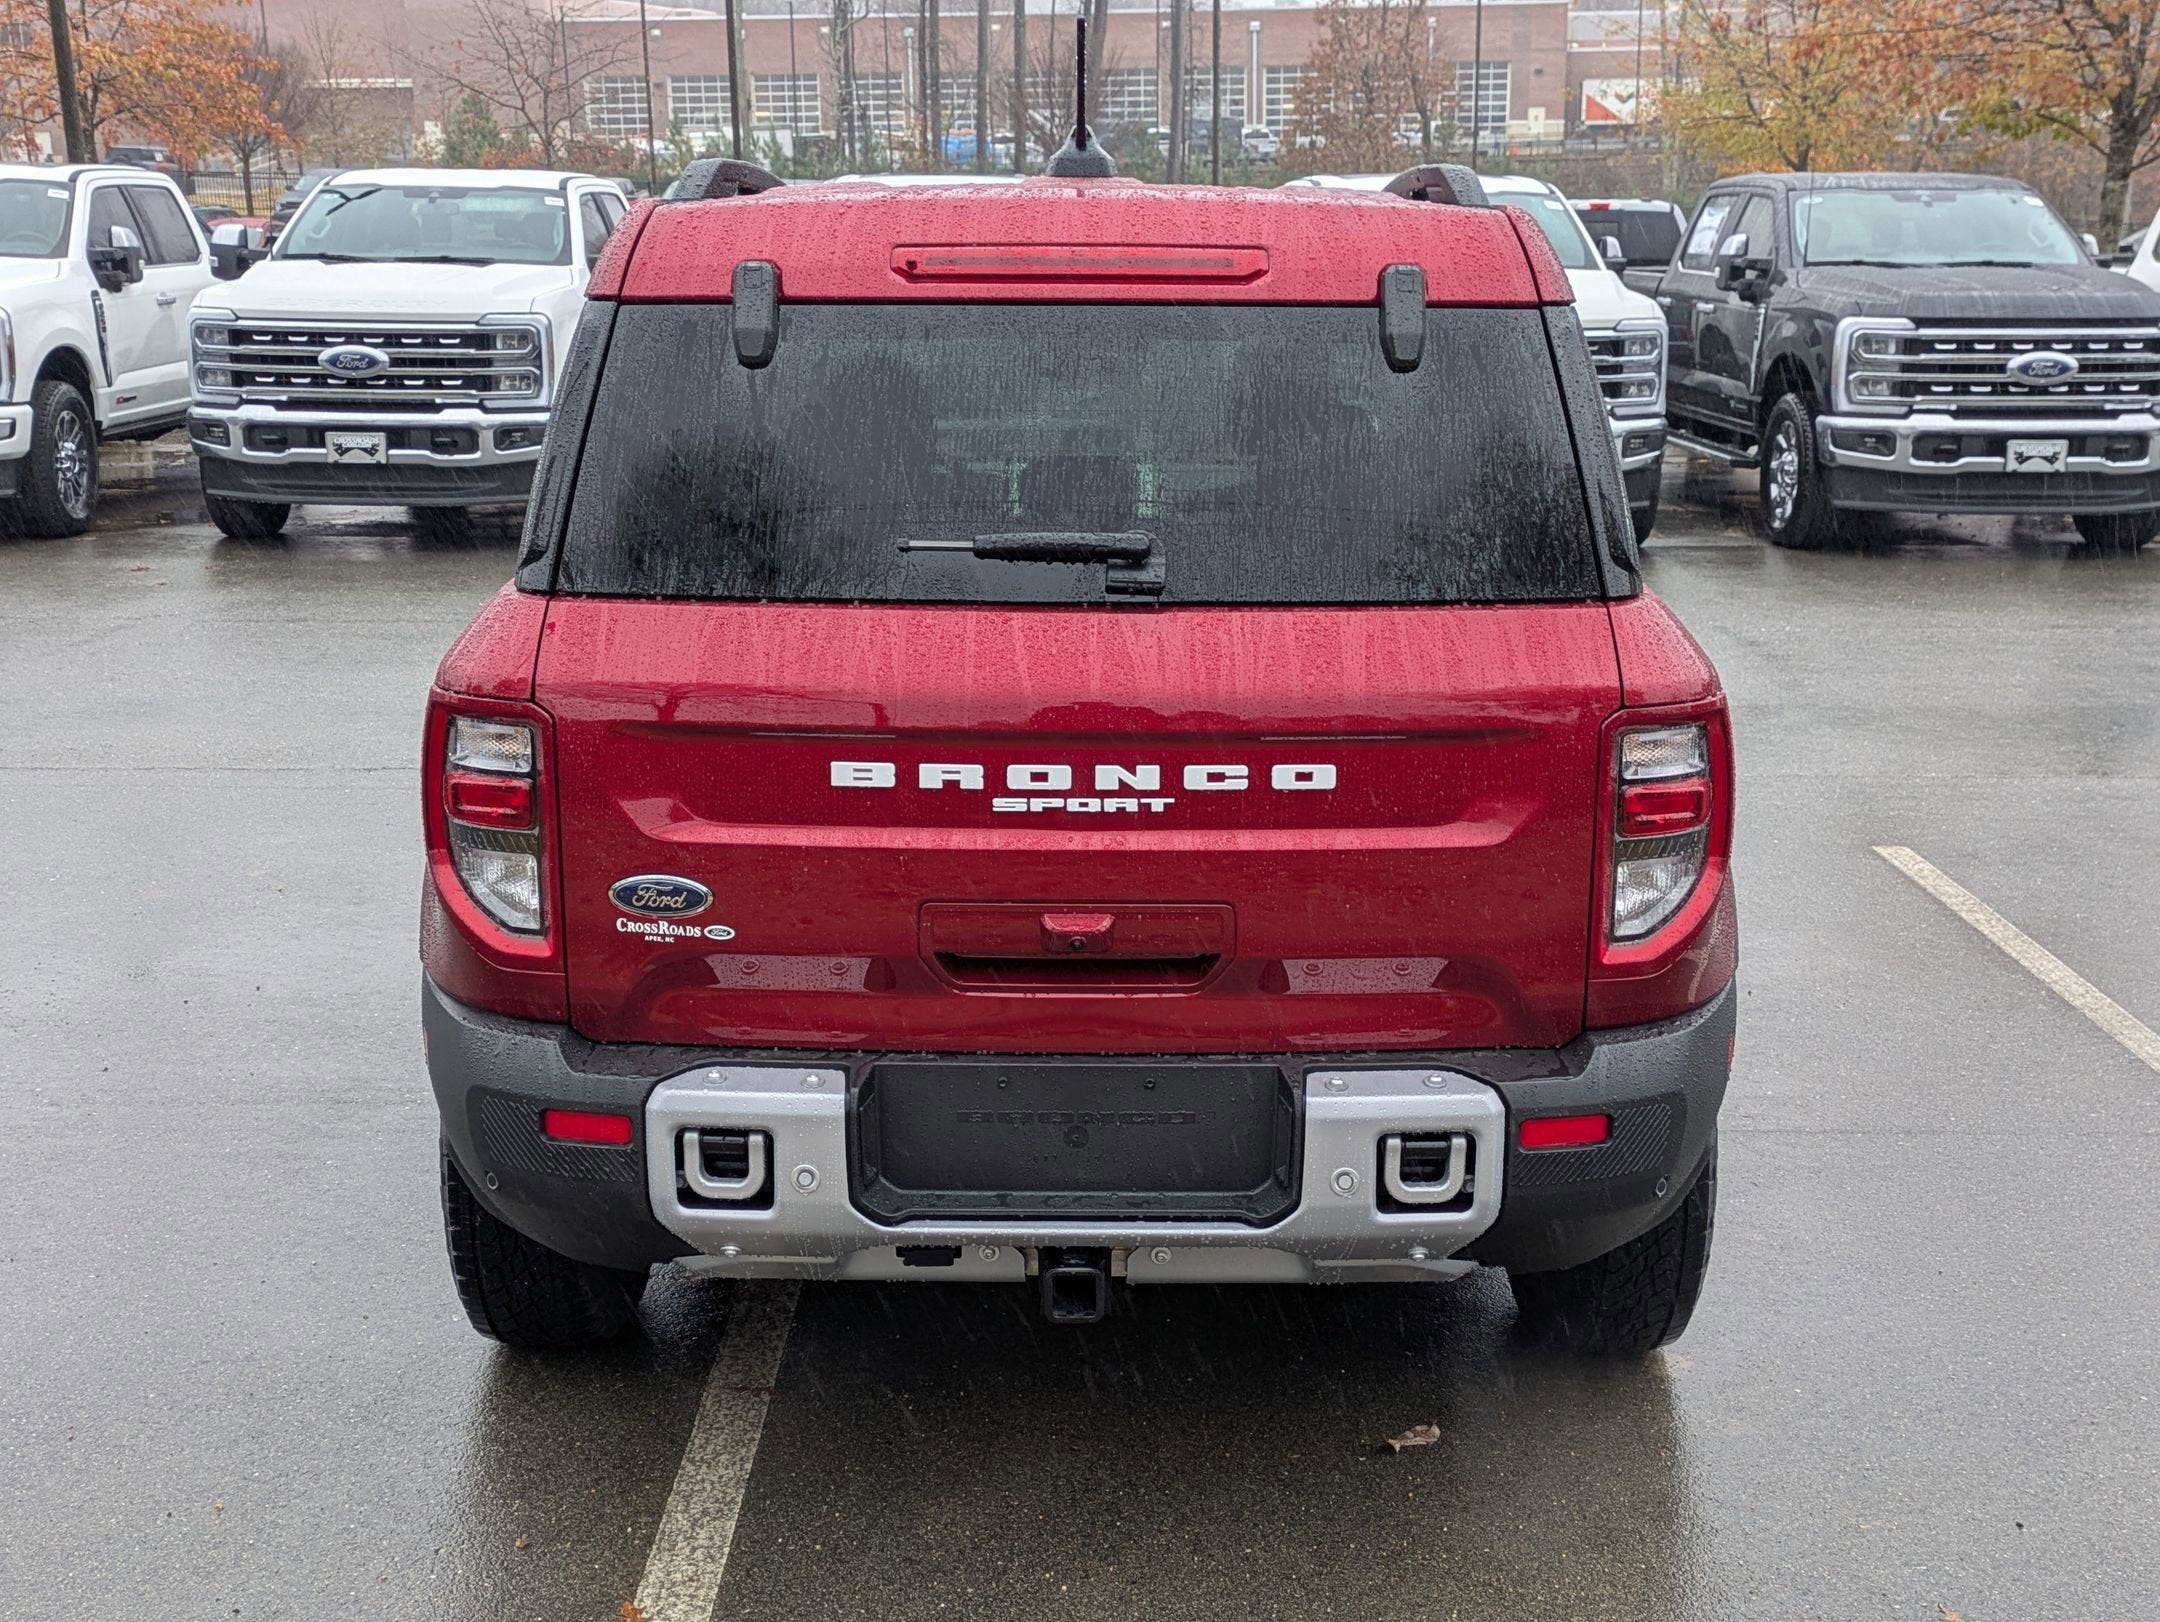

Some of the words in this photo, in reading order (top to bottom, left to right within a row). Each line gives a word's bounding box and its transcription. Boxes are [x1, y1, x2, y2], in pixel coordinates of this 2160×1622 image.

[336, 354, 369, 368] Ford
[2028, 361, 2062, 376] Ford
[830, 761, 1337, 791] BRONCO
[992, 797, 1175, 812] SPORT
[632, 884, 687, 907] Ford
[956, 1110, 1196, 1125] BRONCO
